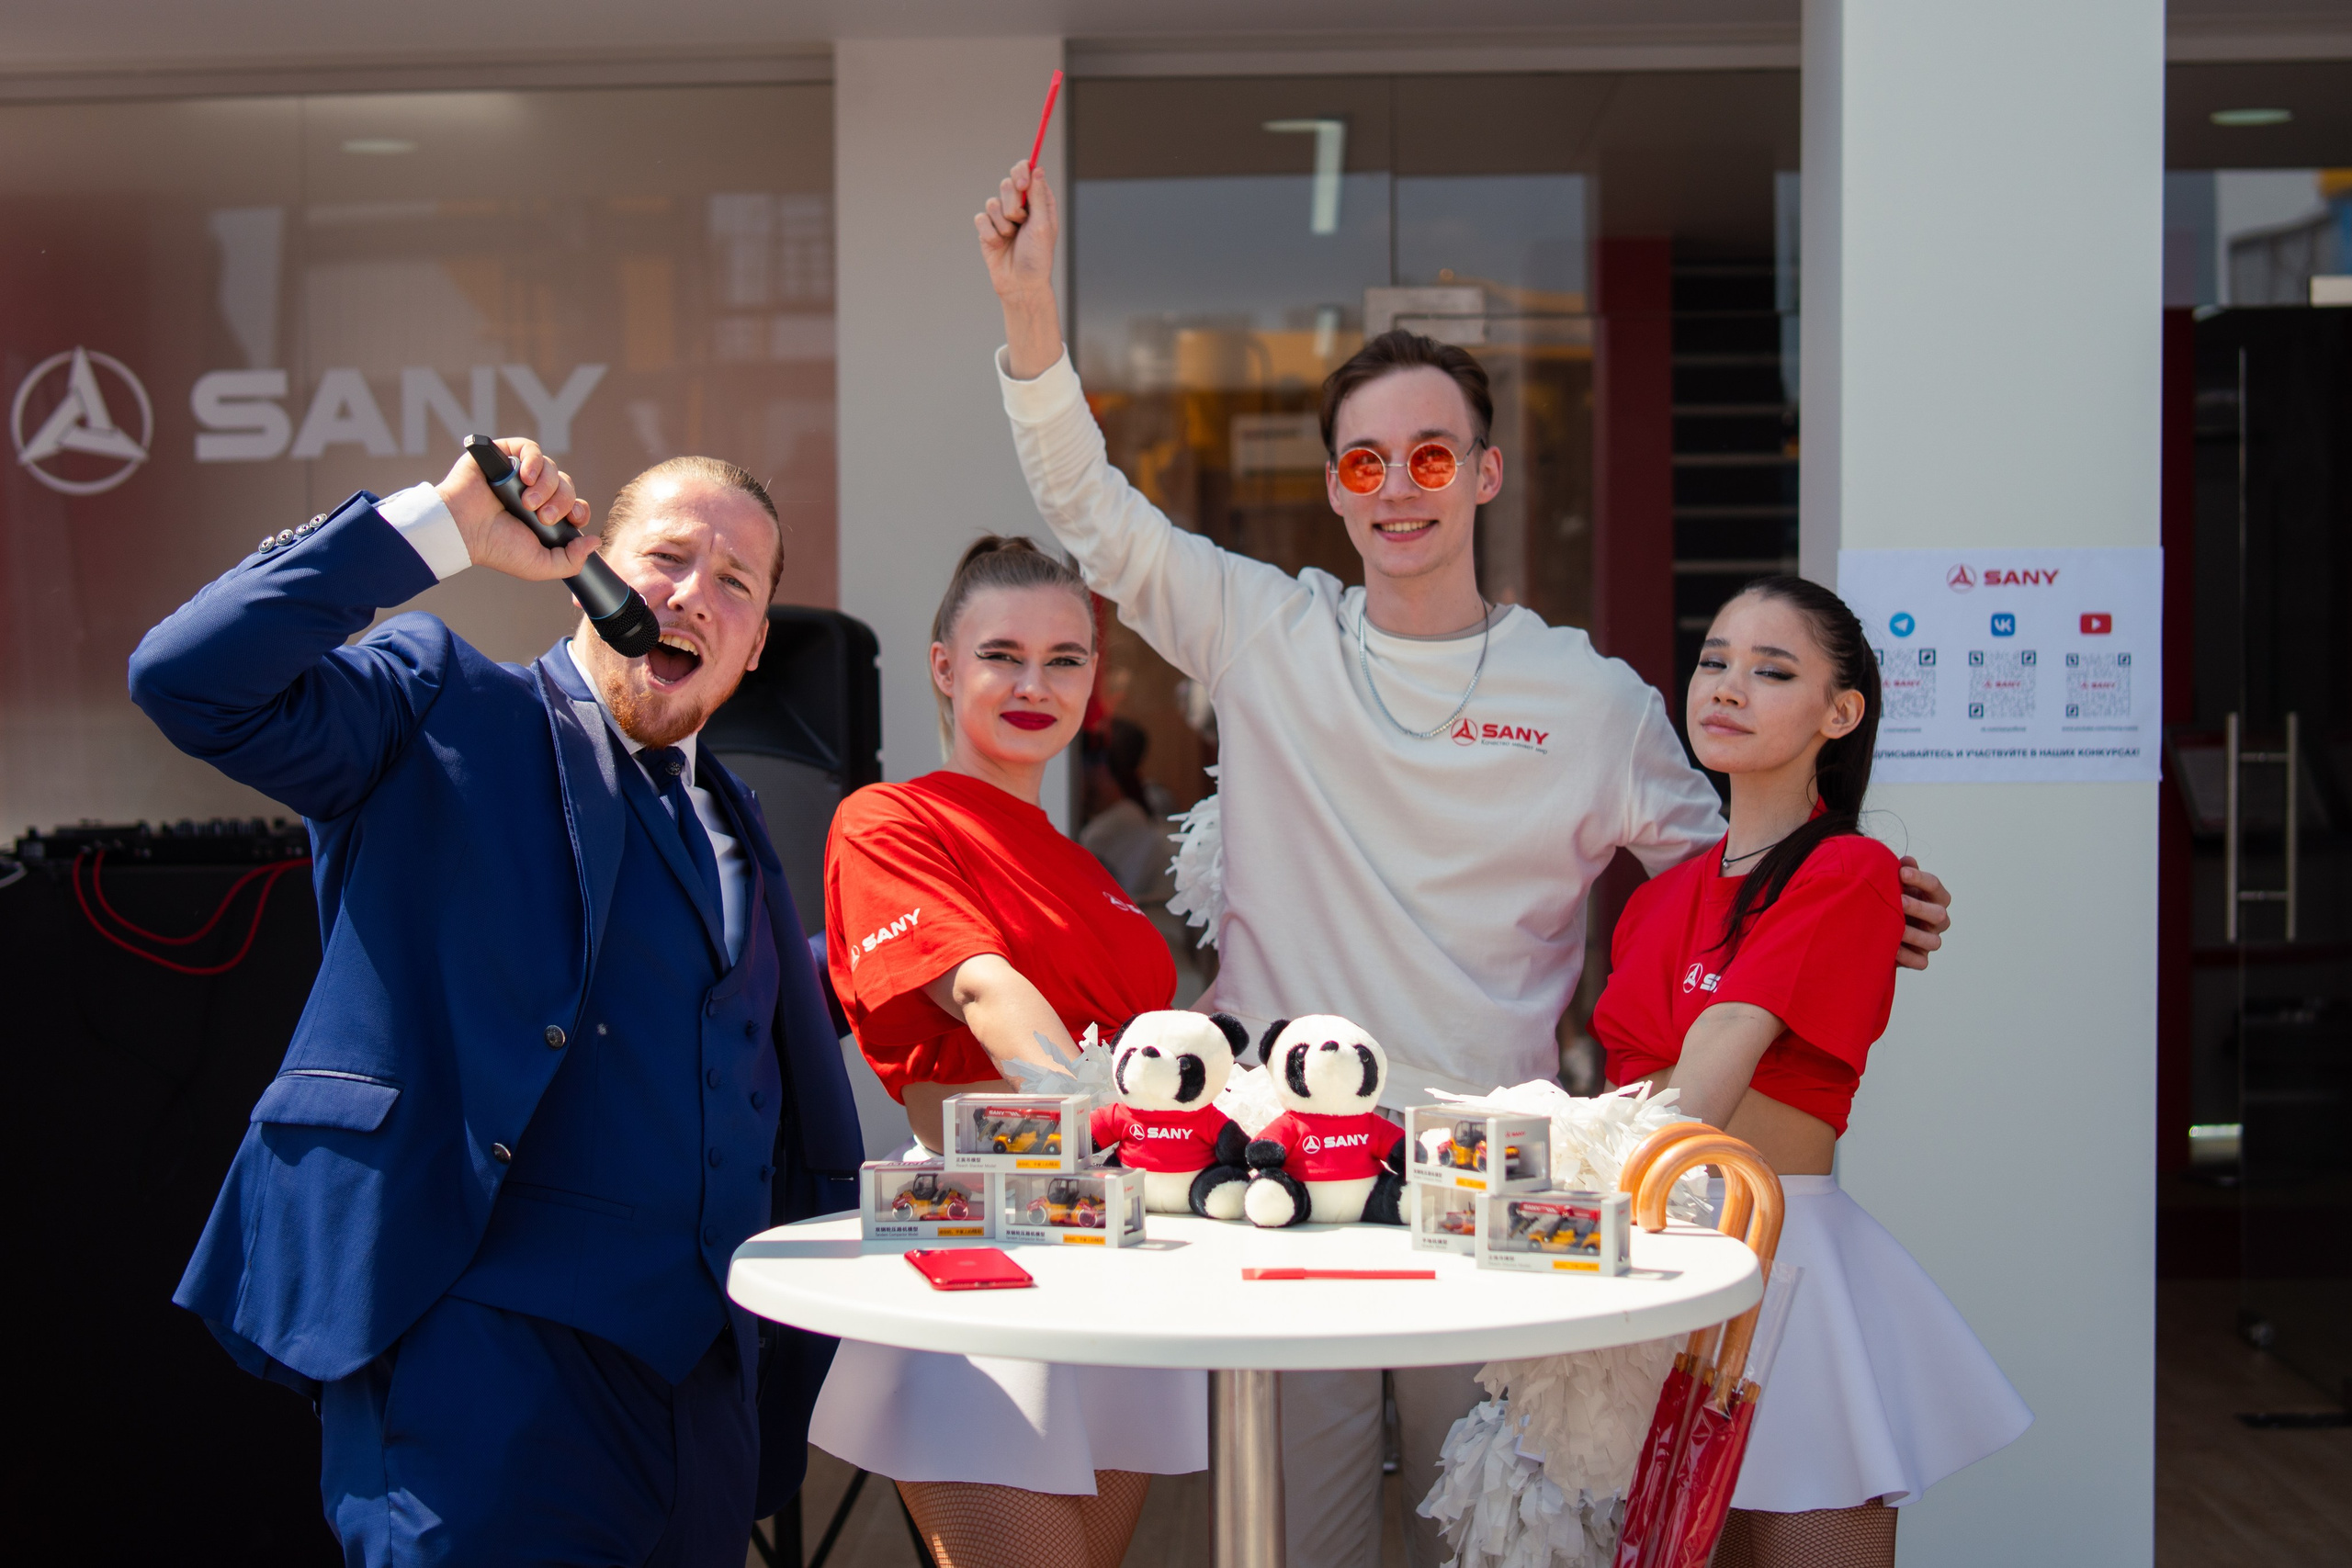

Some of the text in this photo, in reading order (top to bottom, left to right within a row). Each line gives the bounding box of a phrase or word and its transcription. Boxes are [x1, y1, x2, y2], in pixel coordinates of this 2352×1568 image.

[190, 364, 609, 463] SANY
[1983, 569, 2060, 587] SANY
[1481, 723, 1550, 746] SANY
[1481, 739, 1548, 755] Качество меняет мир
[1872, 747, 1954, 760] ДПИСЫВАЙТЕСЬ
[1956, 749, 1963, 758] И
[1966, 747, 2028, 758] УЧАСТВУЙТЕ
[2030, 748, 2038, 758] В
[2040, 748, 2076, 758] НАШИХ
[861, 908, 921, 953] SANY
[1700, 973, 1722, 993] S
[1147, 1127, 1193, 1140] SANY
[1323, 1134, 1370, 1148] SANY
